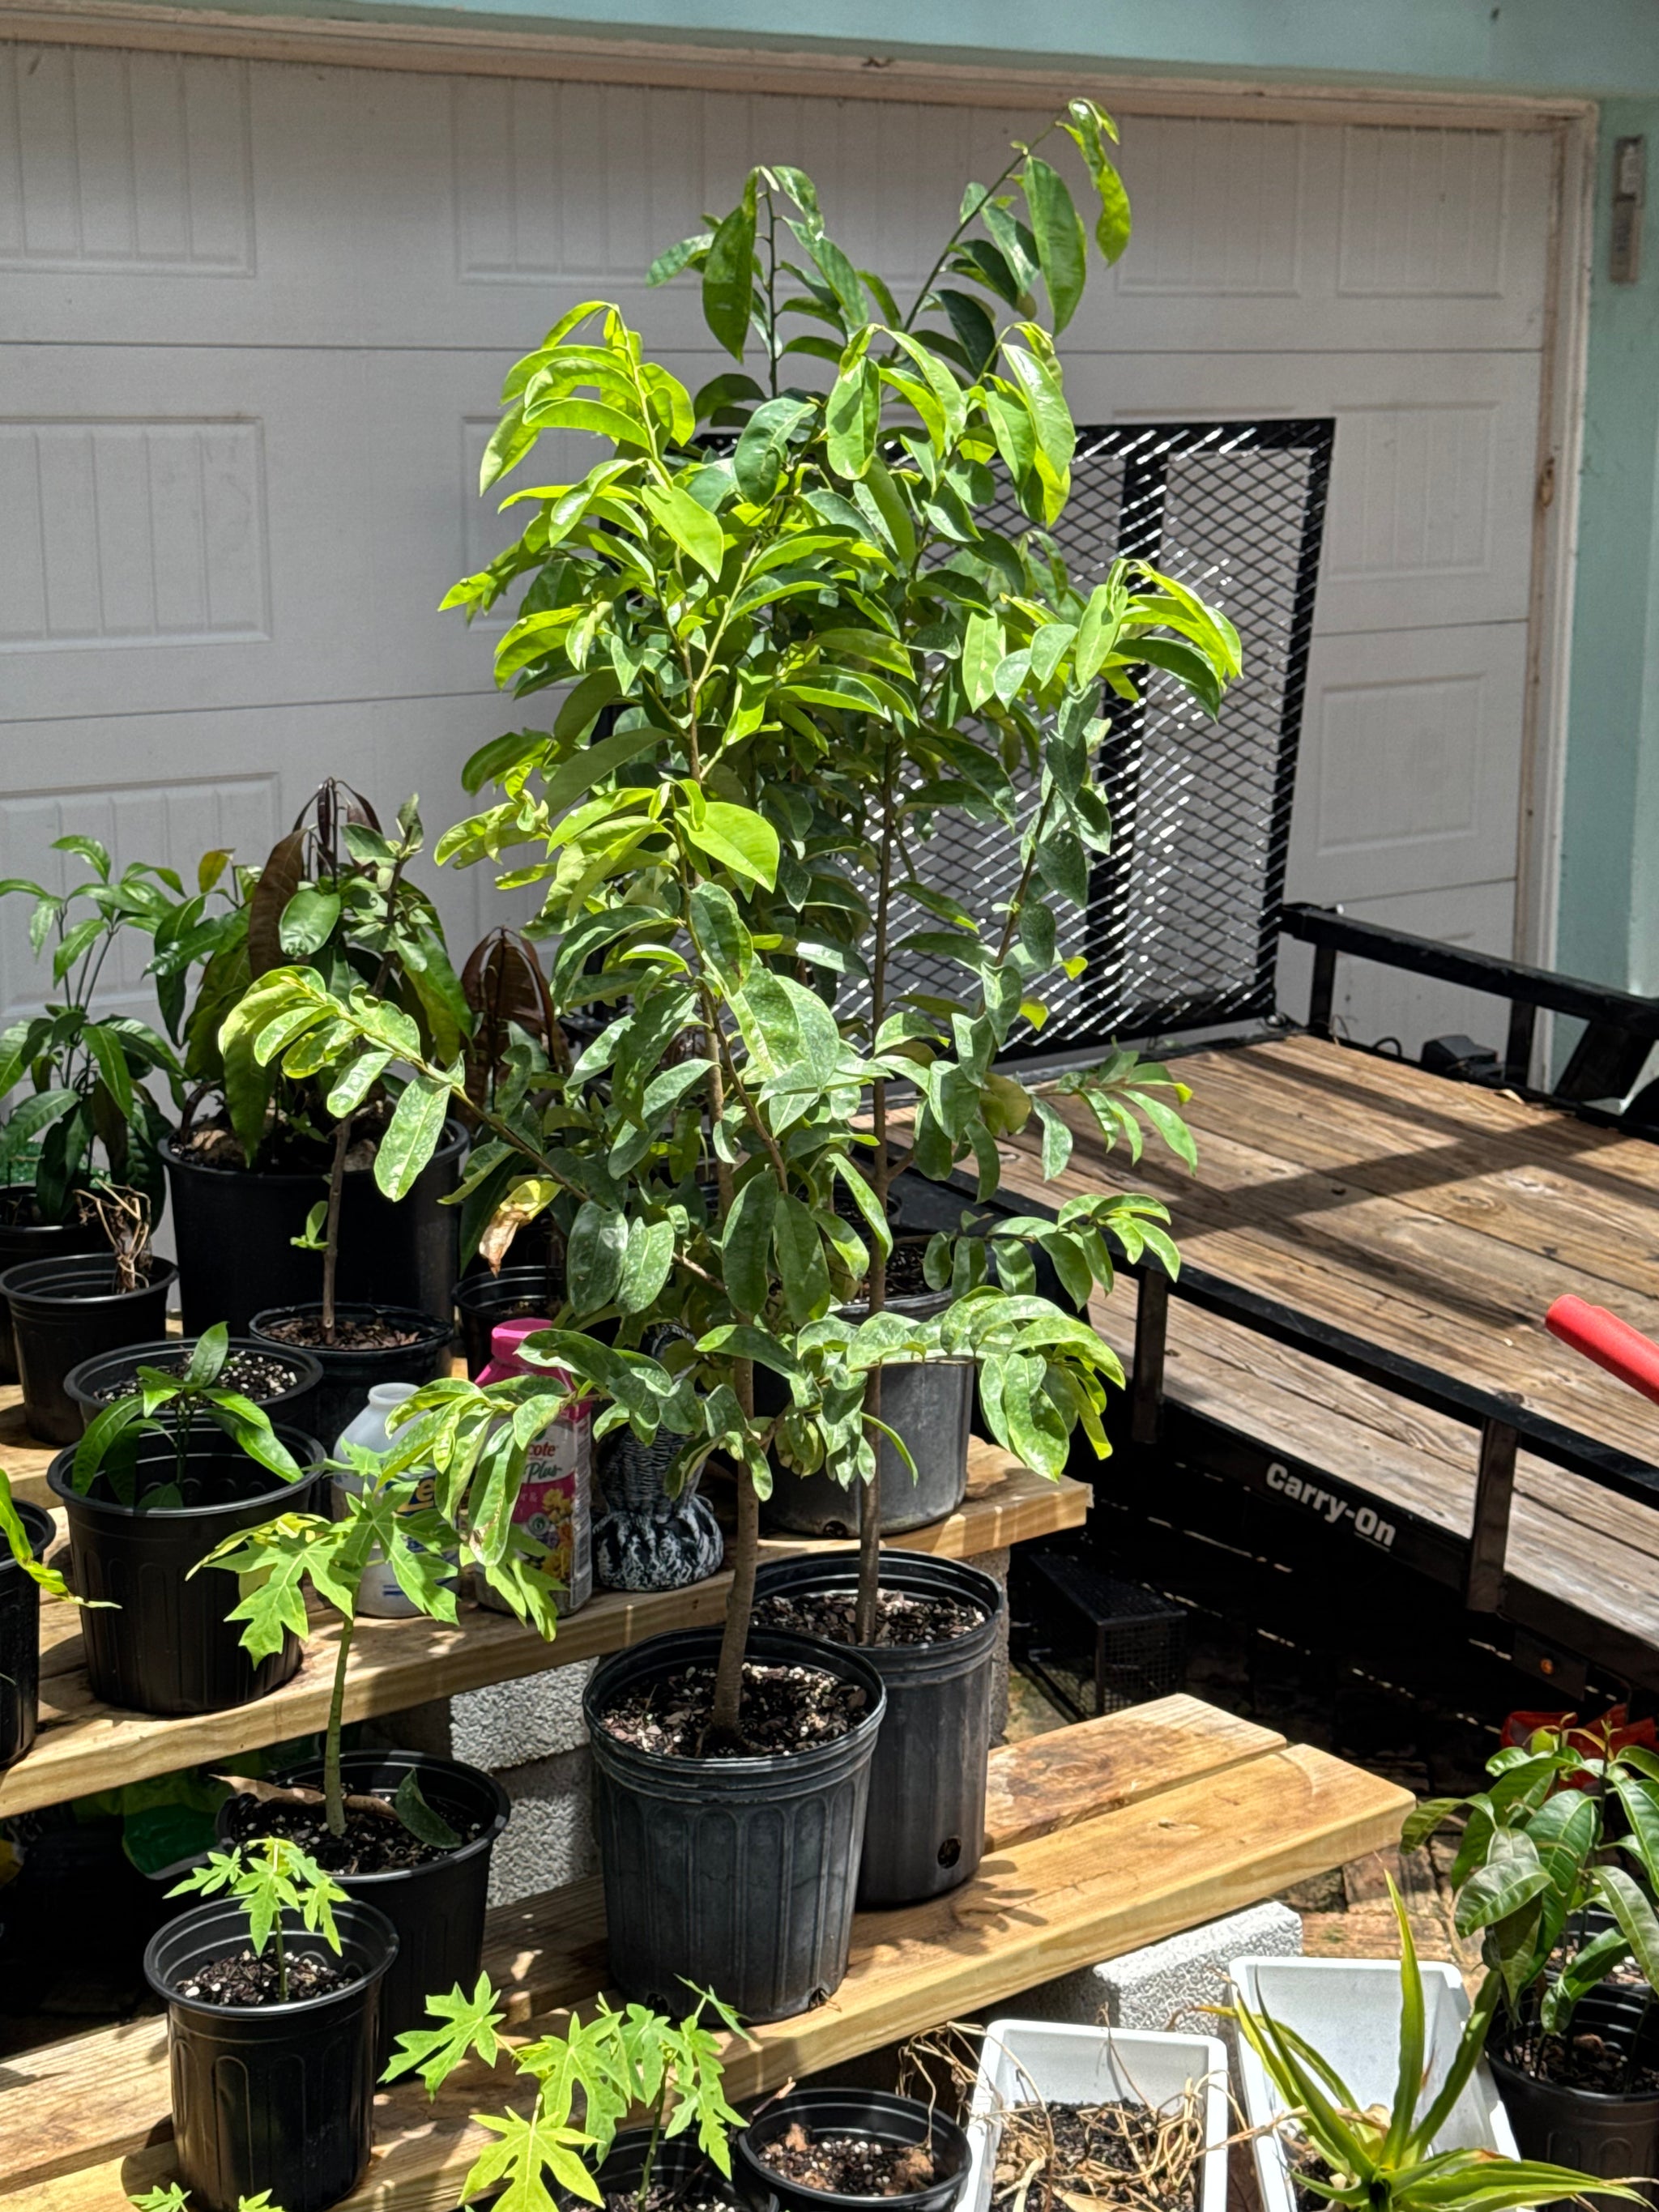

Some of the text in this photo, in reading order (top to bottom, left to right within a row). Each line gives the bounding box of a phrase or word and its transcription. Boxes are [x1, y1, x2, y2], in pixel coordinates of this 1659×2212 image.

[528, 1442, 556, 1456] cote
[524, 1461, 562, 1483] Plus
[1266, 1462, 1396, 1547] Carry-On
